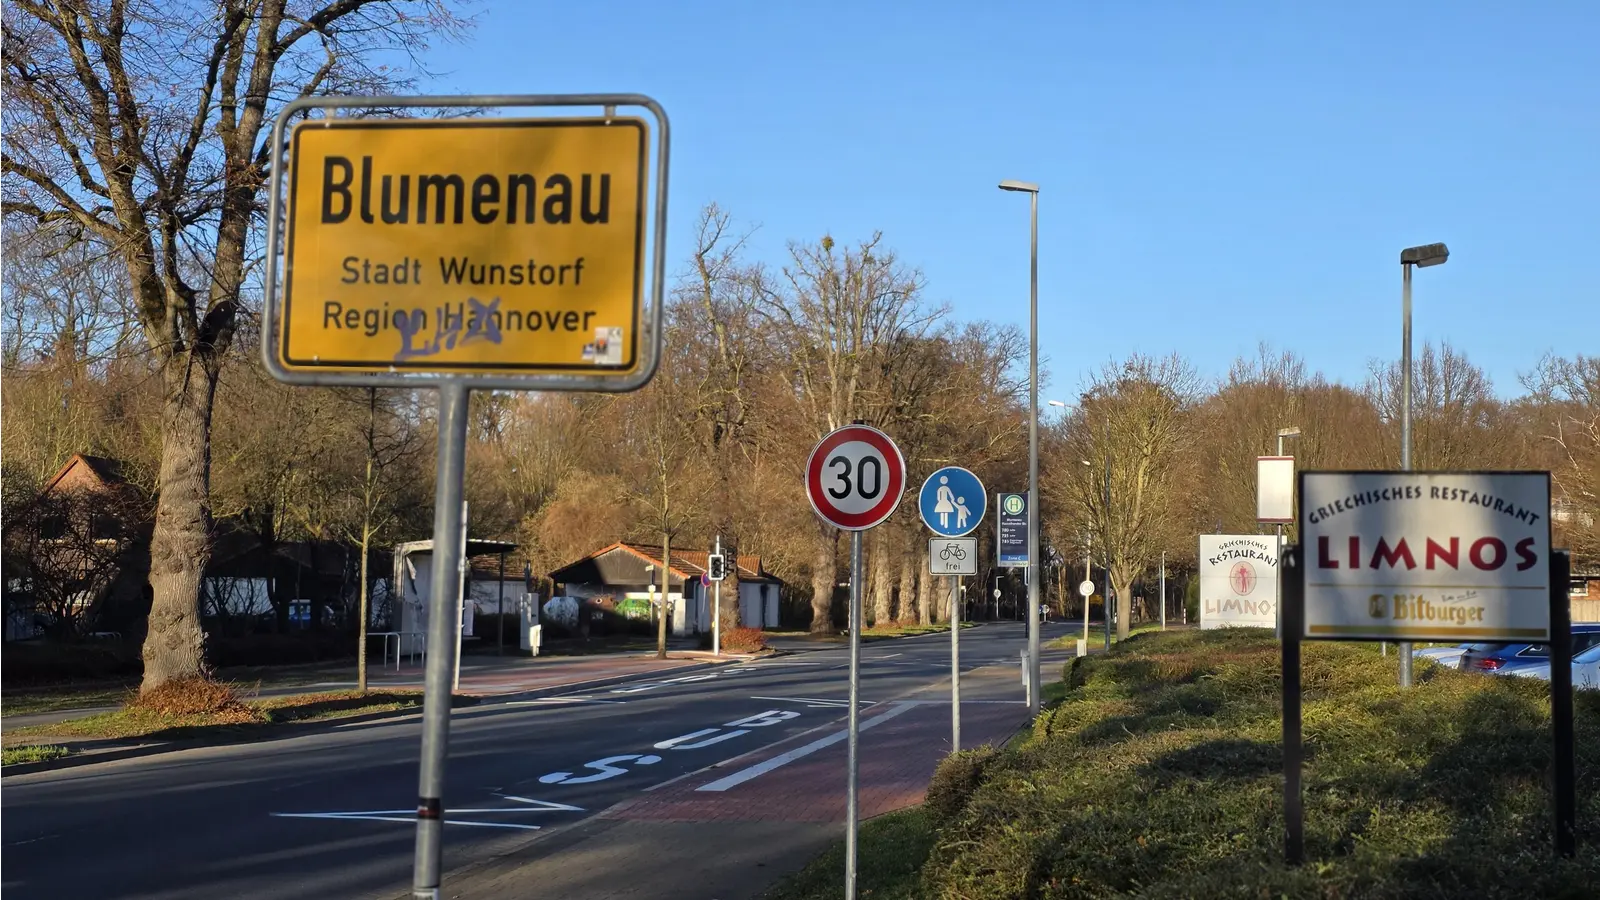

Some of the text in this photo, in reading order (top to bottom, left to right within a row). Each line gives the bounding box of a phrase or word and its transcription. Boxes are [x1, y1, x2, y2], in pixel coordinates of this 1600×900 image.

[321, 155, 611, 225] Blumenau
[341, 256, 585, 286] Stadt Wunstorf
[323, 301, 427, 336] Region
[443, 302, 597, 332] Hannover
[828, 455, 882, 500] 30
[1308, 484, 1540, 527] GRIECHISCHES RESTAURANT
[1218, 539, 1268, 551] GRIECHISCHES
[1317, 535, 1539, 573] LIMNOS
[945, 562, 961, 571] frei
[1392, 593, 1485, 626] Bitburger
[538, 709, 801, 785] BUS
